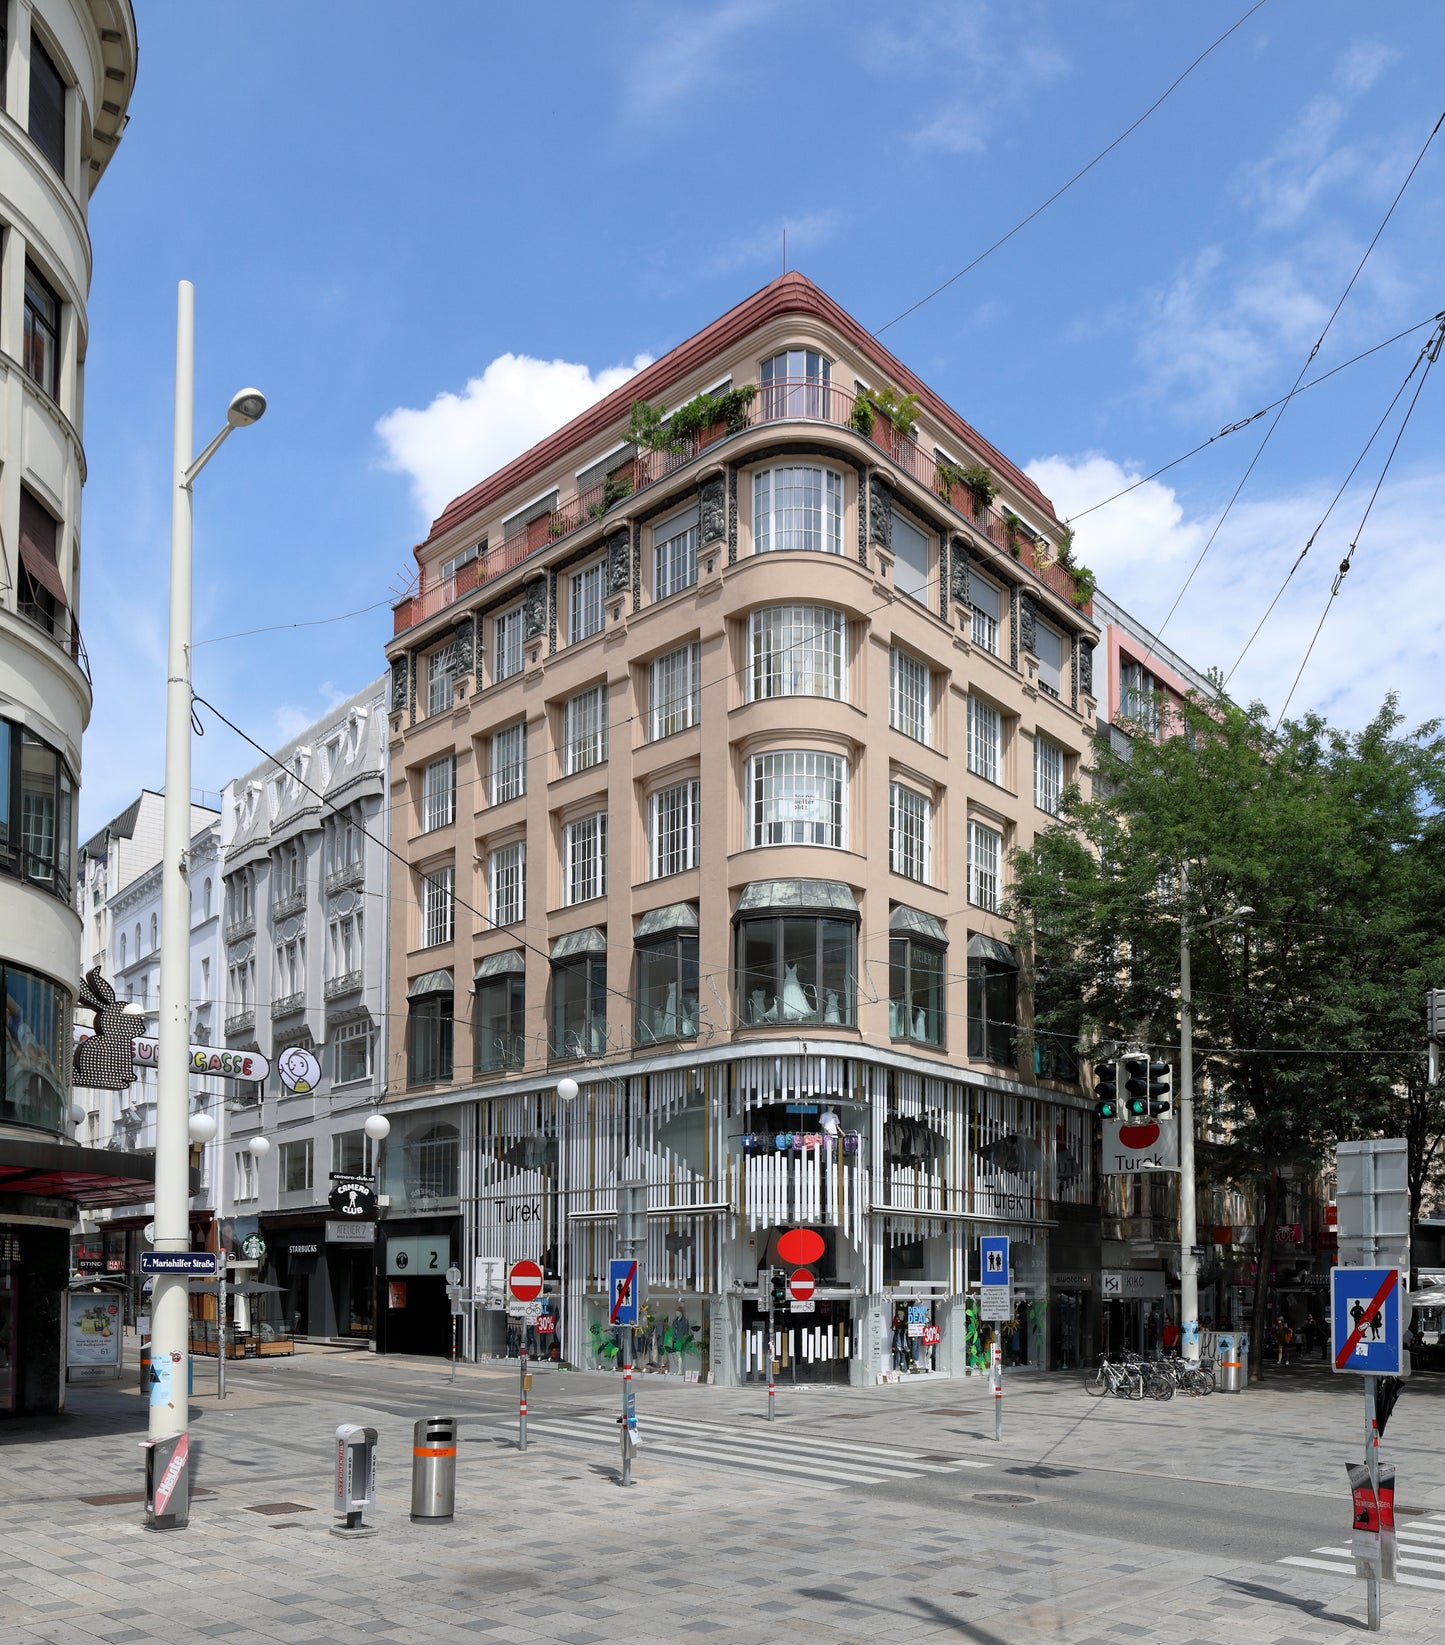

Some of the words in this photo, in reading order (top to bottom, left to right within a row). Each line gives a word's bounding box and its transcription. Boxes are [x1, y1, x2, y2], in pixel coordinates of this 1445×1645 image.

[333, 1174, 375, 1182] camera-club.at
[337, 1183, 370, 1196] CAMERA
[985, 1184, 1024, 1210] Turek
[342, 1205, 364, 1215] CLUB
[494, 1198, 541, 1223] Turek
[336, 1224, 361, 1235] ATELIER
[362, 1225, 367, 1235] 7
[289, 1244, 317, 1254] STARBUCKS
[152, 1258, 192, 1268] Mariahilfer
[193, 1259, 215, 1268] Straße
[429, 1251, 438, 1269] 2
[1126, 1276, 1144, 1288] KIKO
[907, 1313, 927, 1323] DEAL
[157, 1455, 184, 1497] Heute
